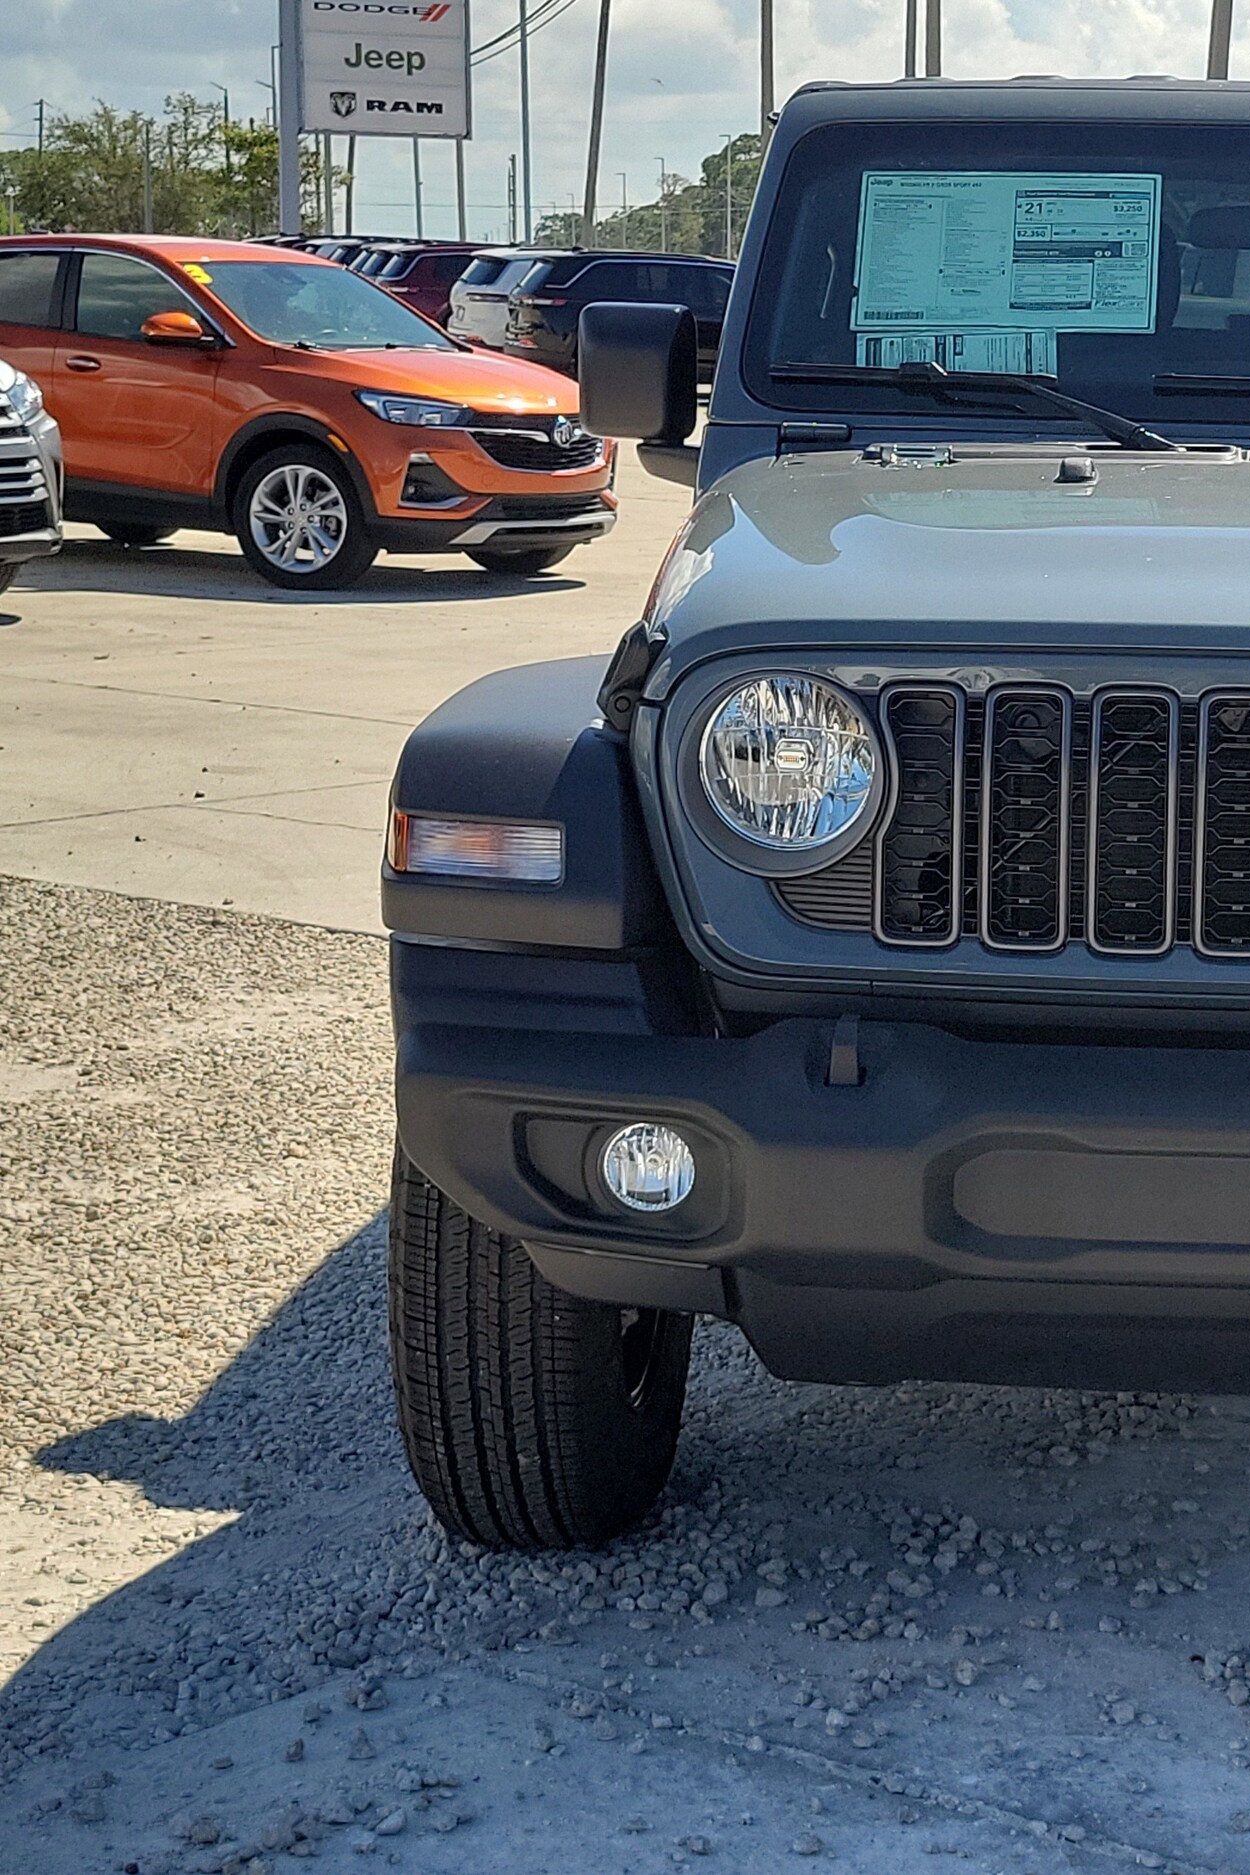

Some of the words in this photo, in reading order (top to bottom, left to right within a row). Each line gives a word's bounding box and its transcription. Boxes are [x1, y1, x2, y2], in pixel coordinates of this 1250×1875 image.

[313, 2, 432, 16] DODGE
[344, 43, 426, 76] Jeep
[366, 99, 443, 114] RAM
[1024, 202, 1043, 215] 21
